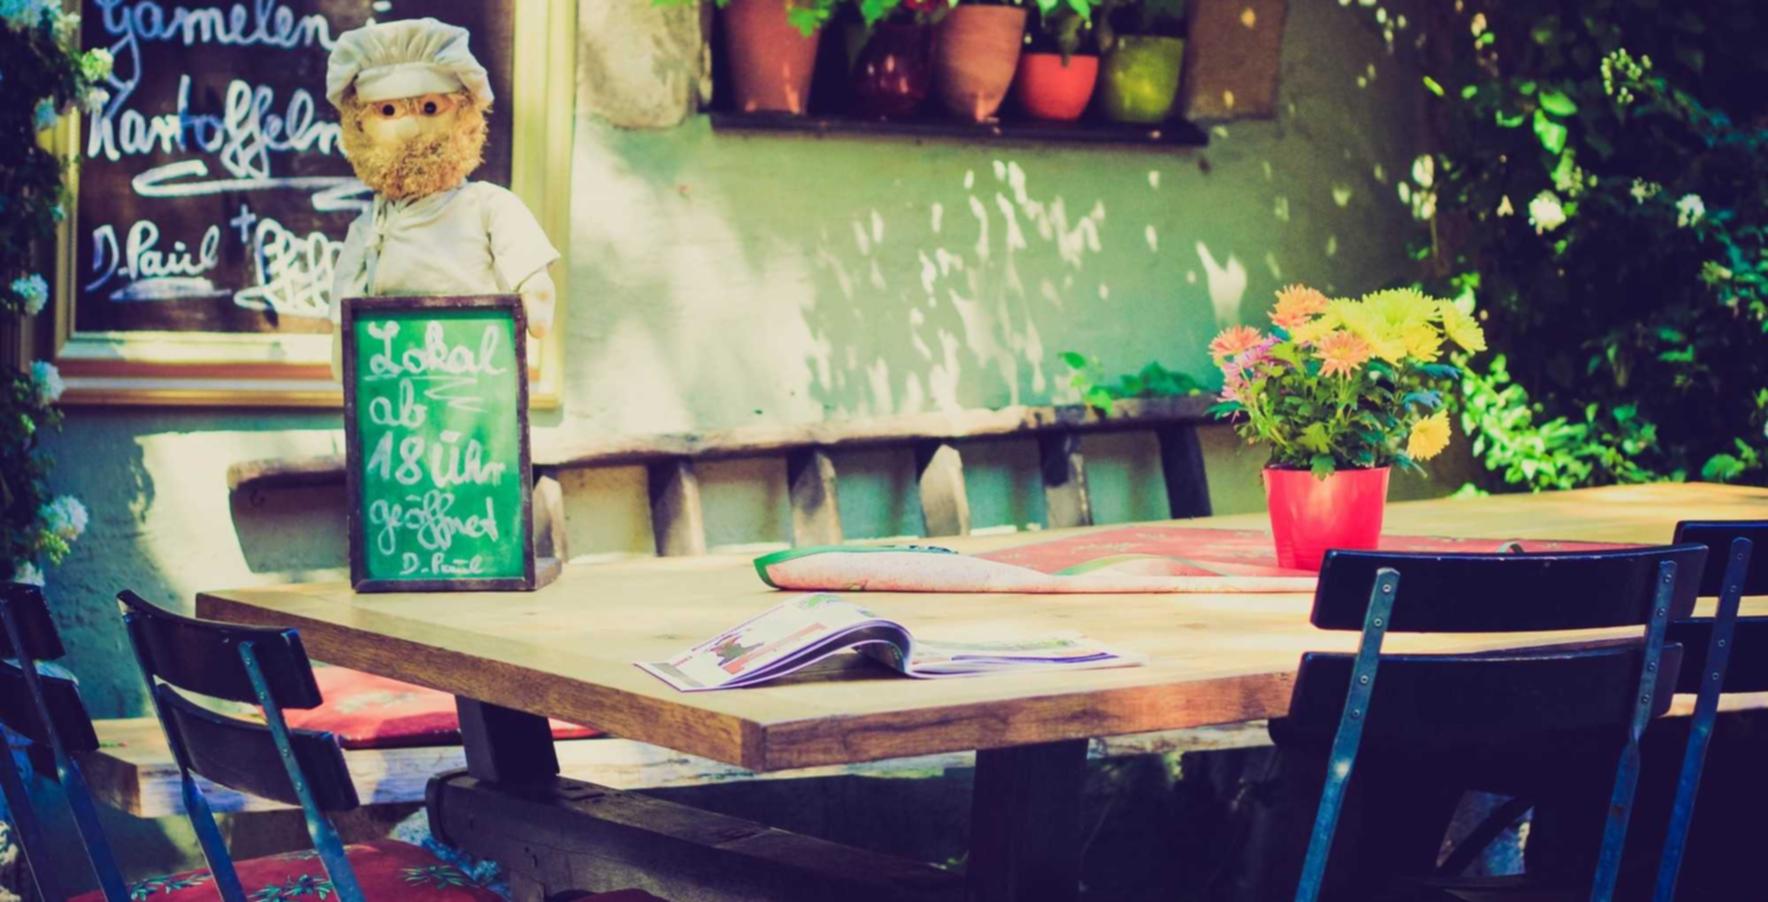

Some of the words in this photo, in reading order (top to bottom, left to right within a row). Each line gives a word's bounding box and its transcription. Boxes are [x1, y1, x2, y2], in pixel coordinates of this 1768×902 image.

[366, 320, 507, 375] Lokal
[369, 378, 428, 428] ab
[367, 432, 425, 486] 18
